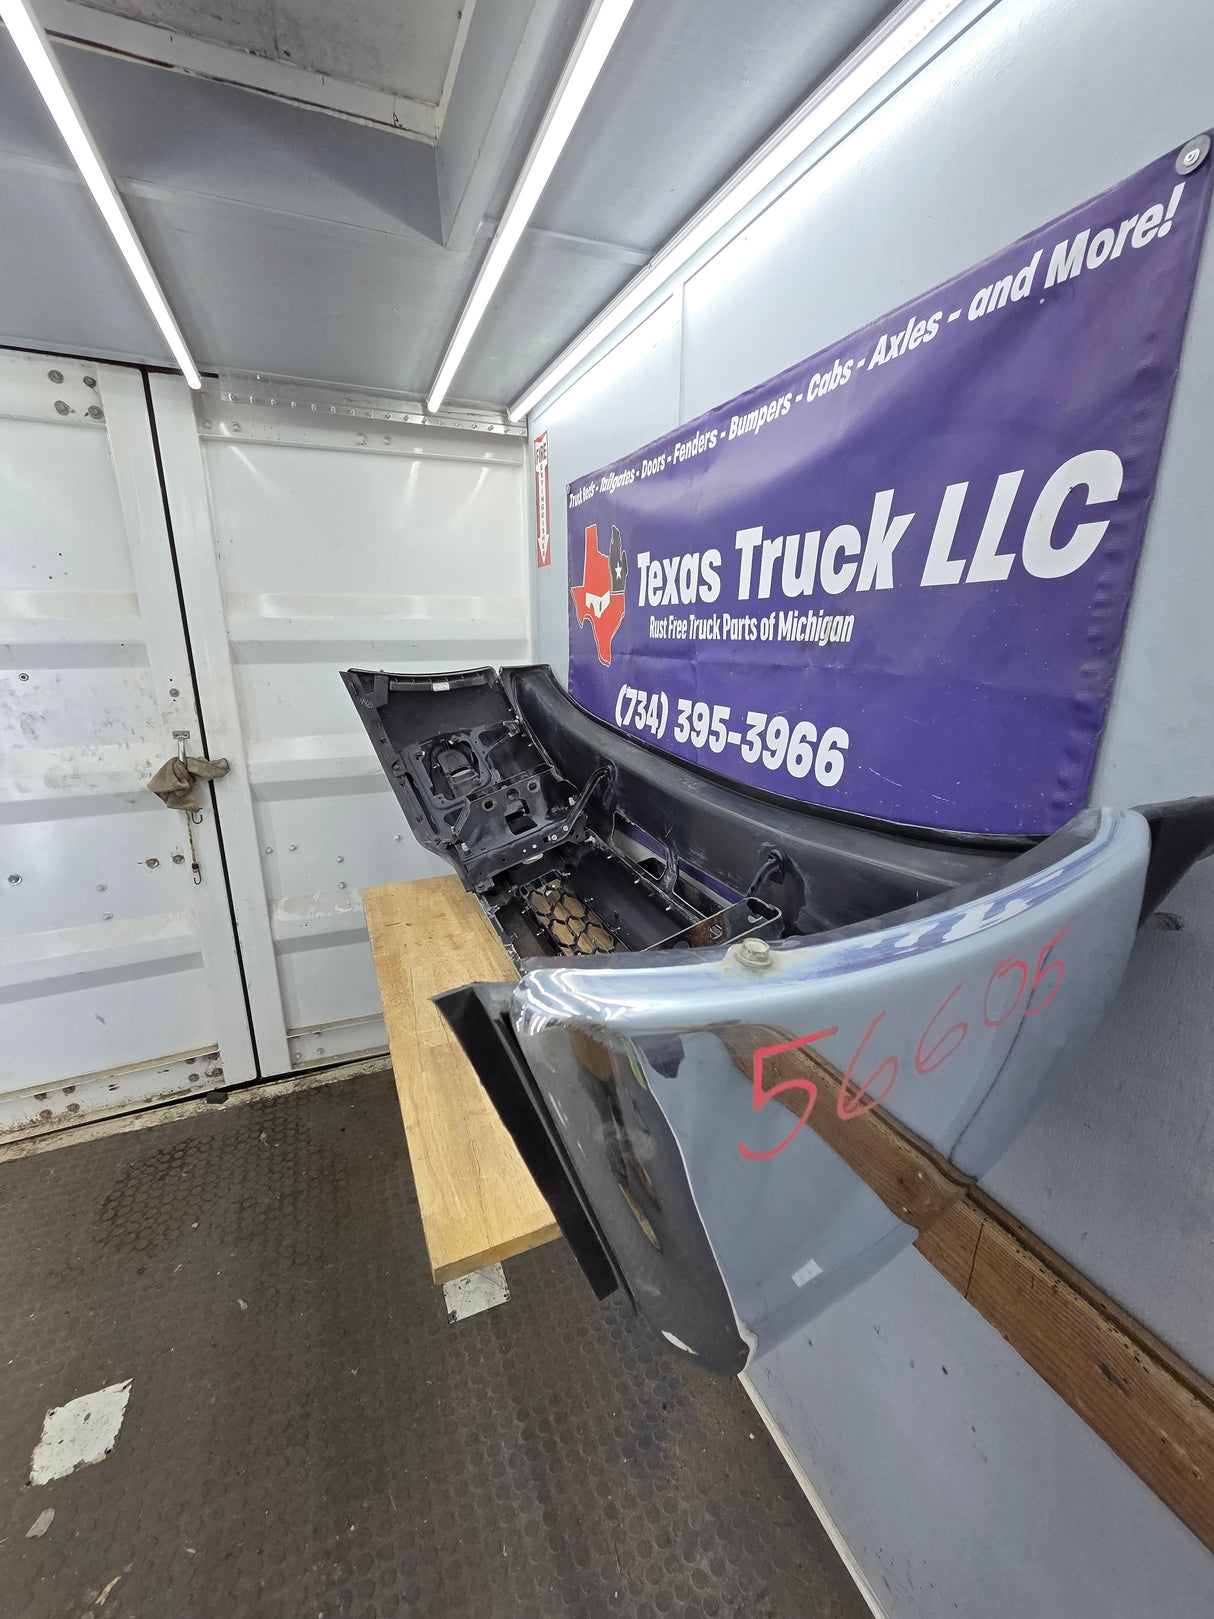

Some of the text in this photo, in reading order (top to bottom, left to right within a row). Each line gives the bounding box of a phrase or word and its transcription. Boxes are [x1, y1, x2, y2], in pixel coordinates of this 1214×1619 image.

[569, 487, 583, 508] Truck
[583, 481, 595, 502] Beds
[599, 468, 635, 494] Tailgates
[641, 454, 666, 479] Doors
[673, 428, 717, 464] Fenders
[728, 392, 792, 440] Bumpers
[806, 359, 853, 402] Cabs
[867, 311, 943, 371] Axles
[967, 249, 1044, 321] and
[1044, 182, 1186, 289] More!
[637, 449, 1124, 607] Texas Truck LLC
[649, 609, 855, 647] Rust Free Truck Parts of Michigan
[615, 684, 850, 788] (734) 395-3966
[737, 924, 1072, 1161] 56605
